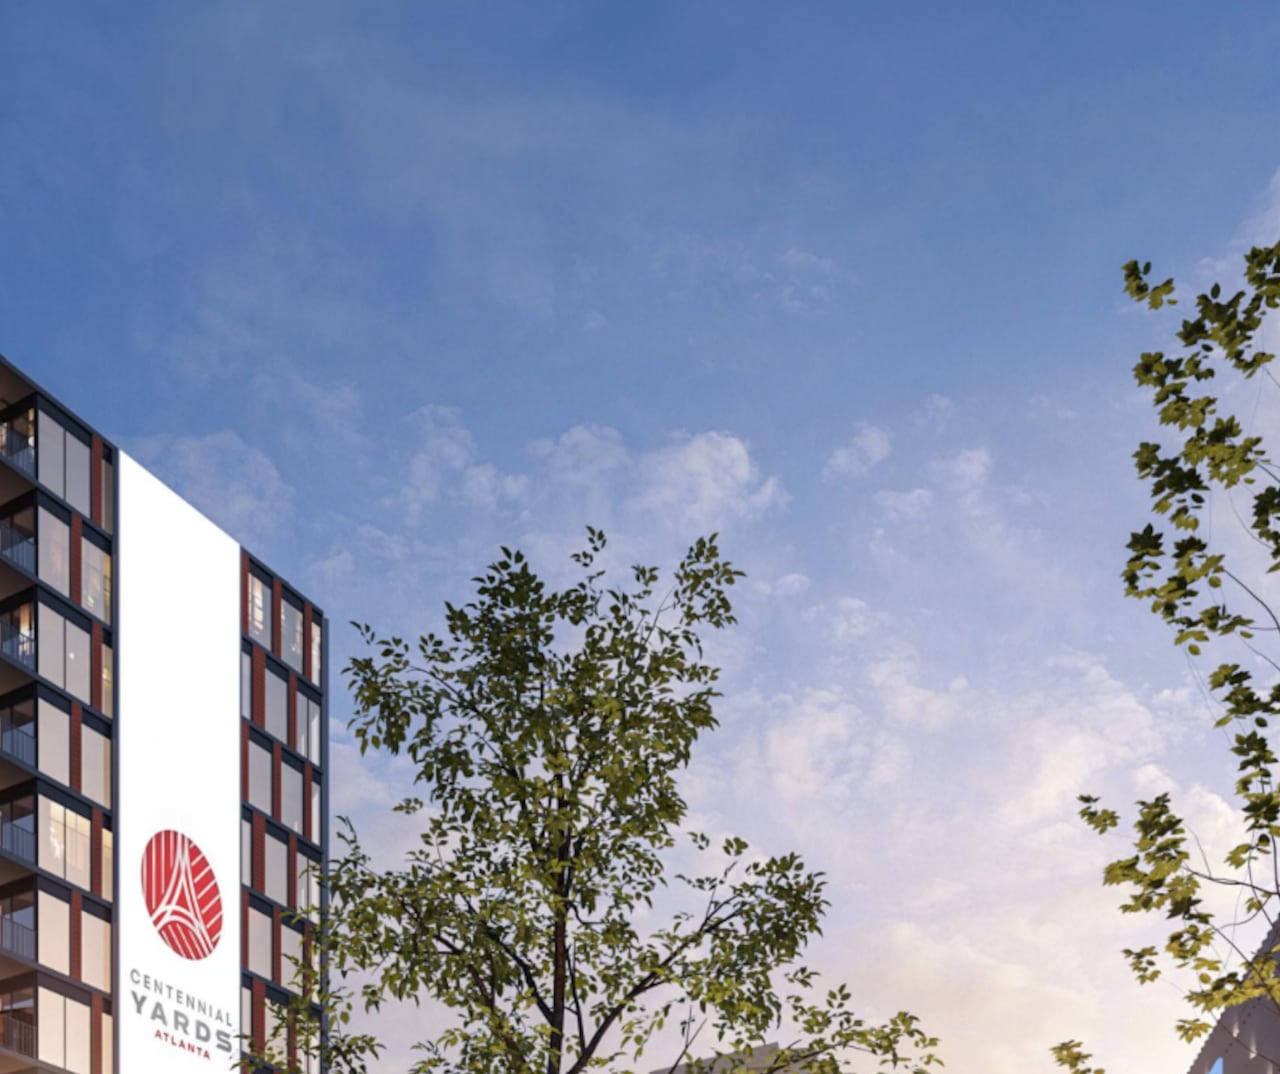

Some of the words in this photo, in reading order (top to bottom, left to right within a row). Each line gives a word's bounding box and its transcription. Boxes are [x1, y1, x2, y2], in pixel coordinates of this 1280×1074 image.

[129, 968, 232, 1027] CENTENNIAL
[130, 990, 232, 1053] YARDS
[154, 1029, 210, 1059] ATLANTA
